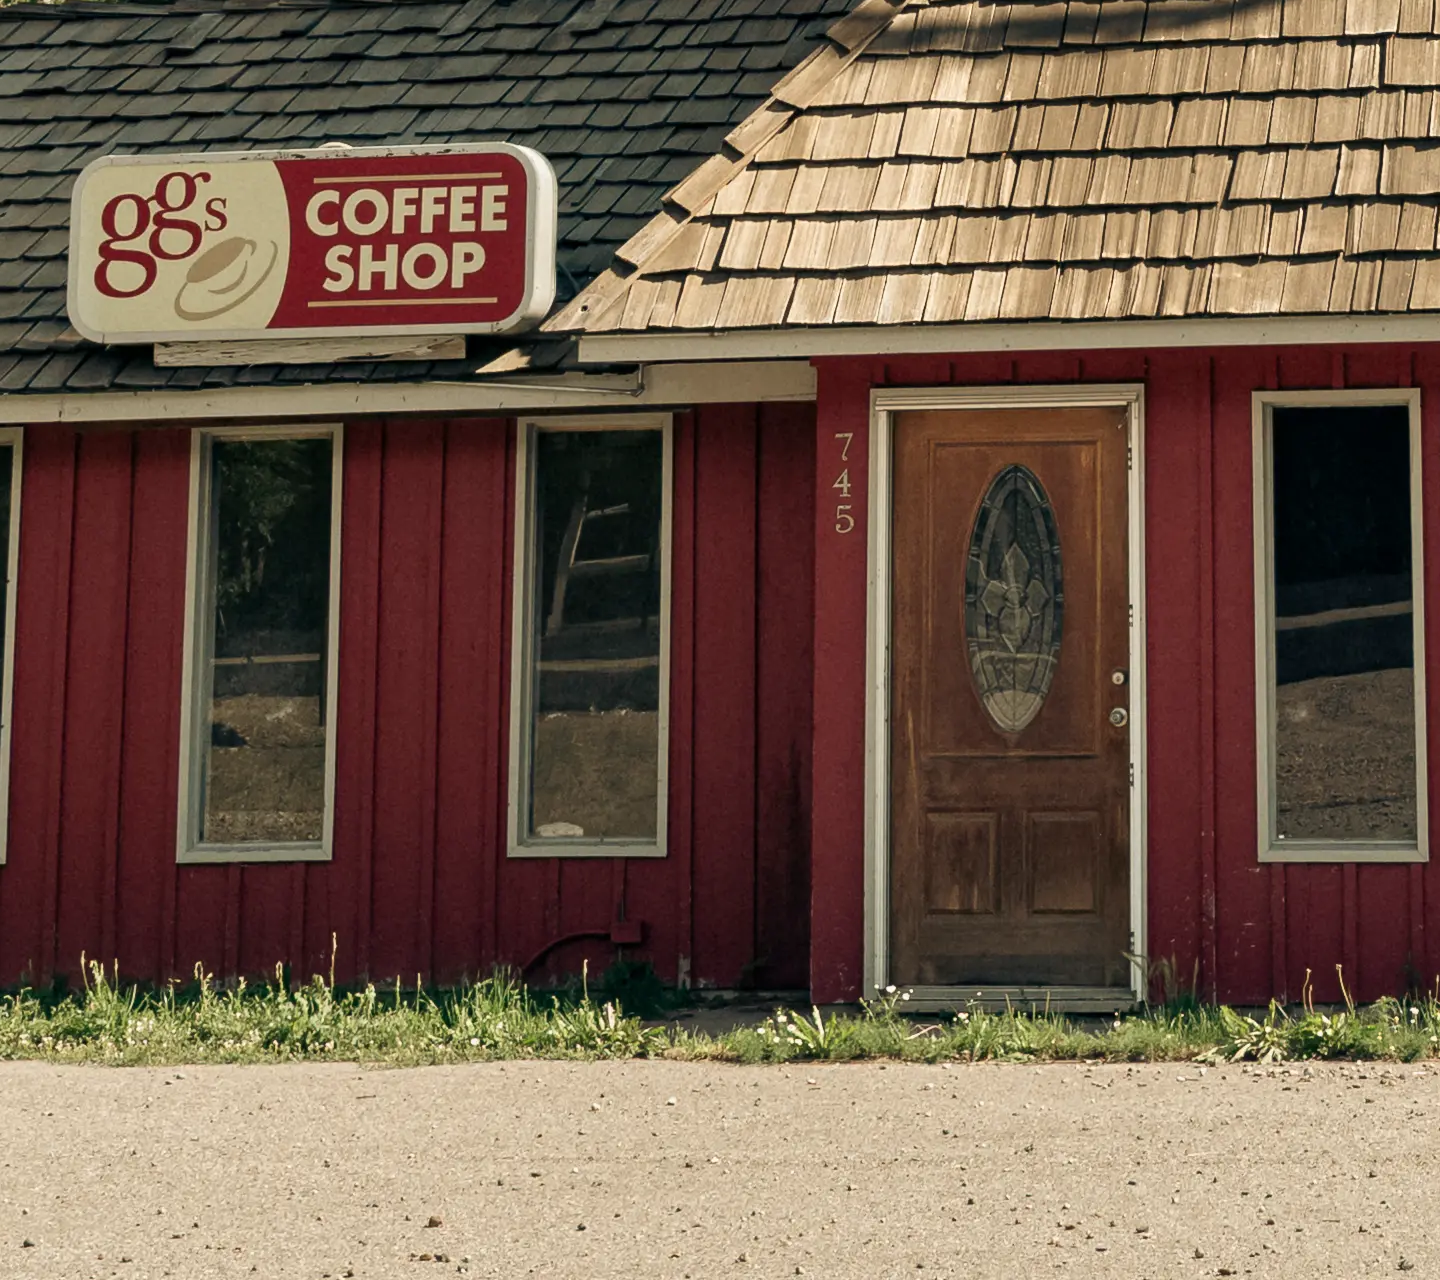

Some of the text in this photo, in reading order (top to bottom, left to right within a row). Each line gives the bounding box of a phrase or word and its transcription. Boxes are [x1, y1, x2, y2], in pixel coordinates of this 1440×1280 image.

[306, 185, 509, 237] COFFEE
[323, 242, 486, 292] SHOP
[832, 433, 854, 533] 745
